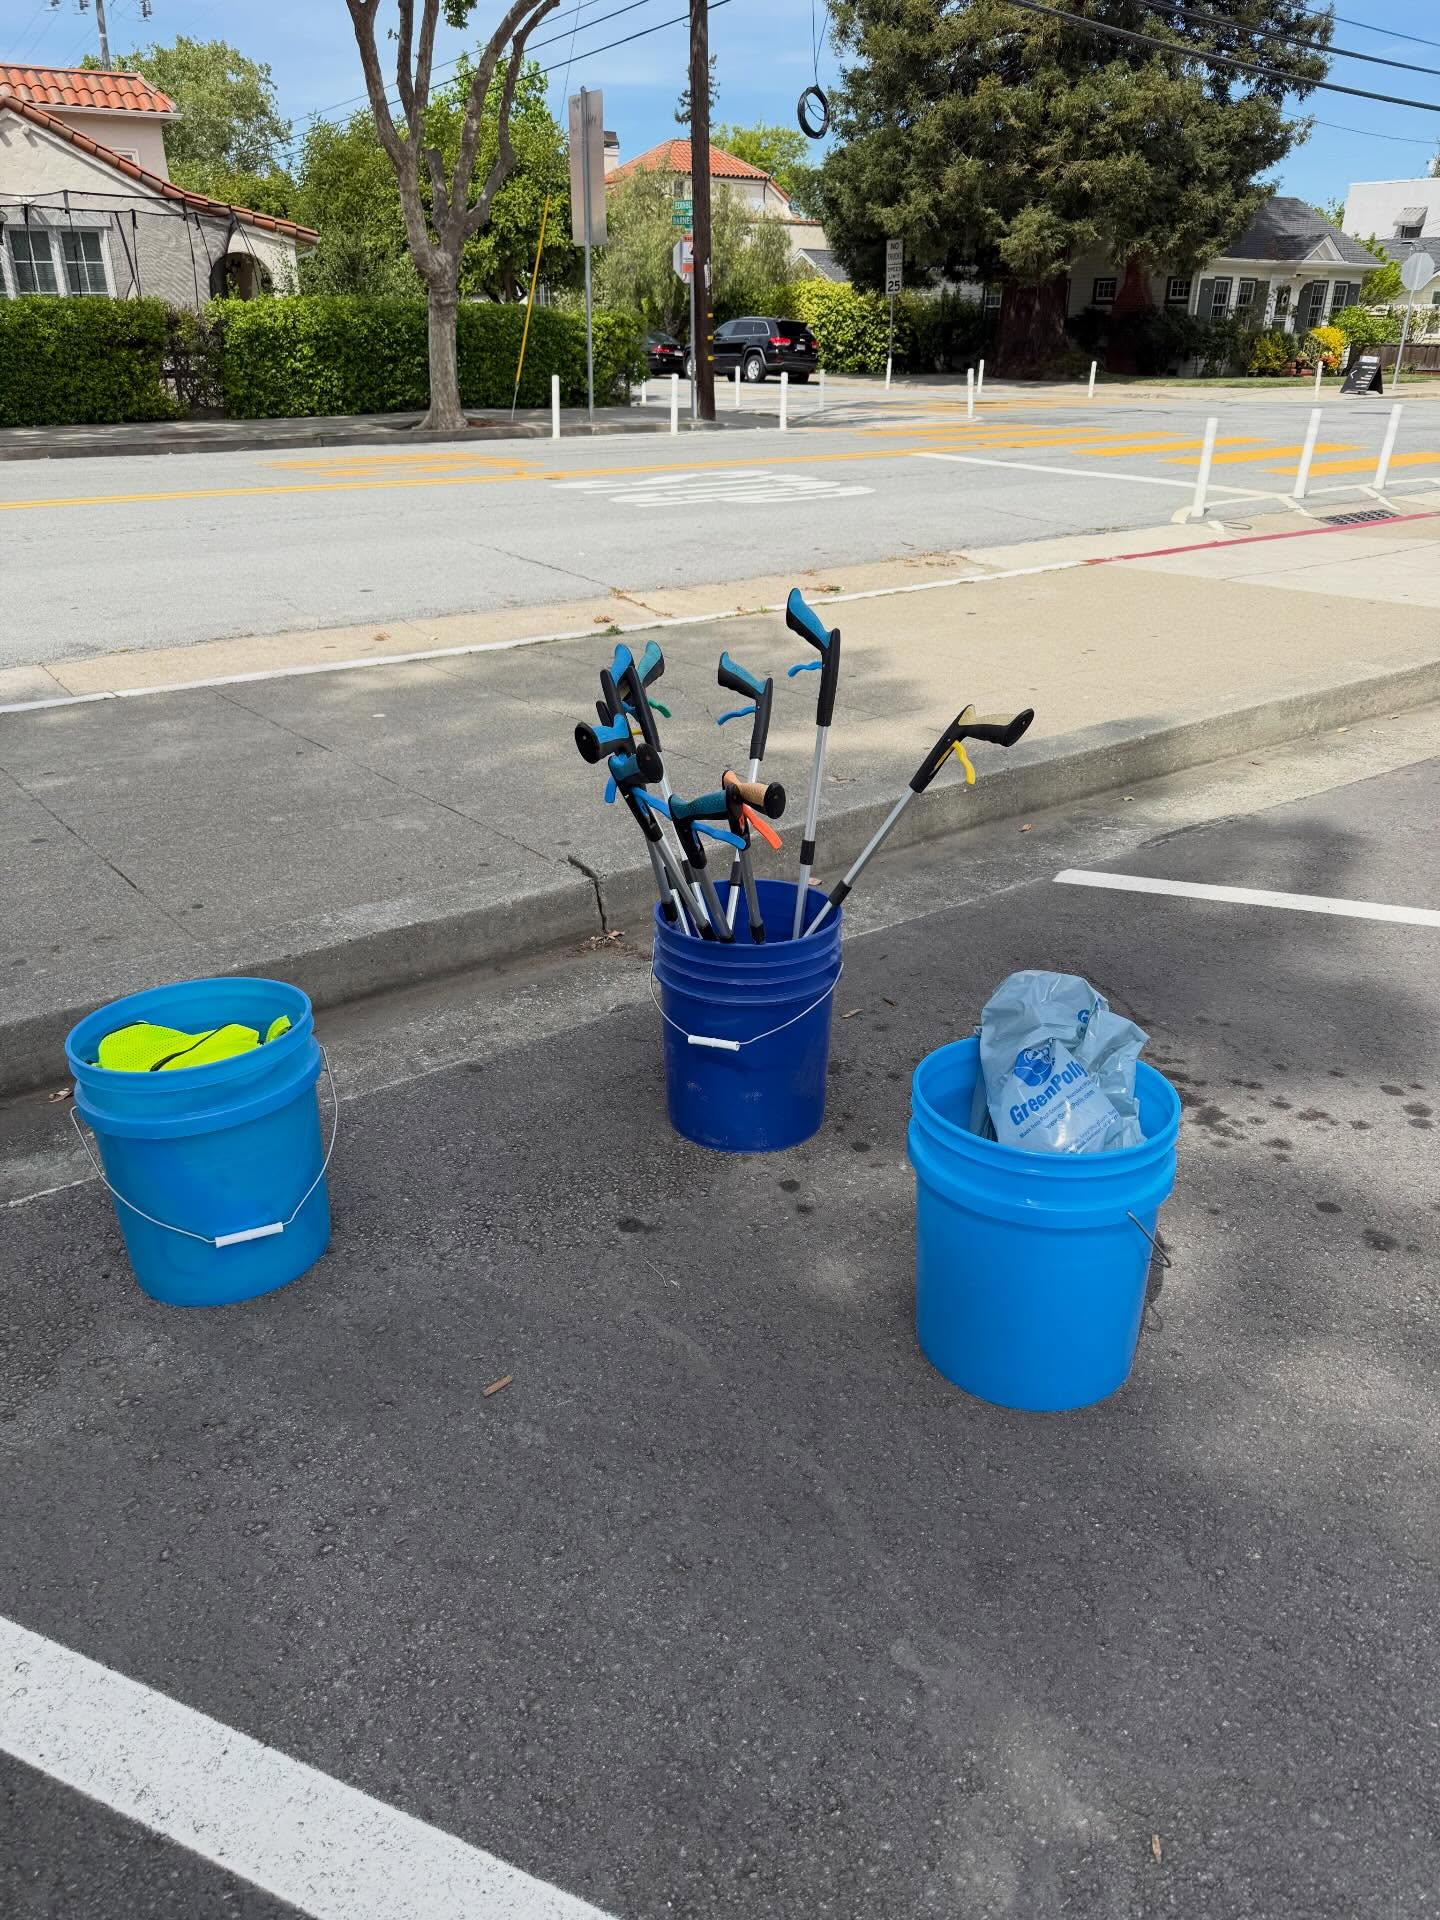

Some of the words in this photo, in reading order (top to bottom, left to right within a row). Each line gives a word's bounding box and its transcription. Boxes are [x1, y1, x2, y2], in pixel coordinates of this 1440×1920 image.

[890, 242, 900, 250] NO
[887, 280, 900, 292] 25
[1009, 1060, 1088, 1126] GreenPolly
